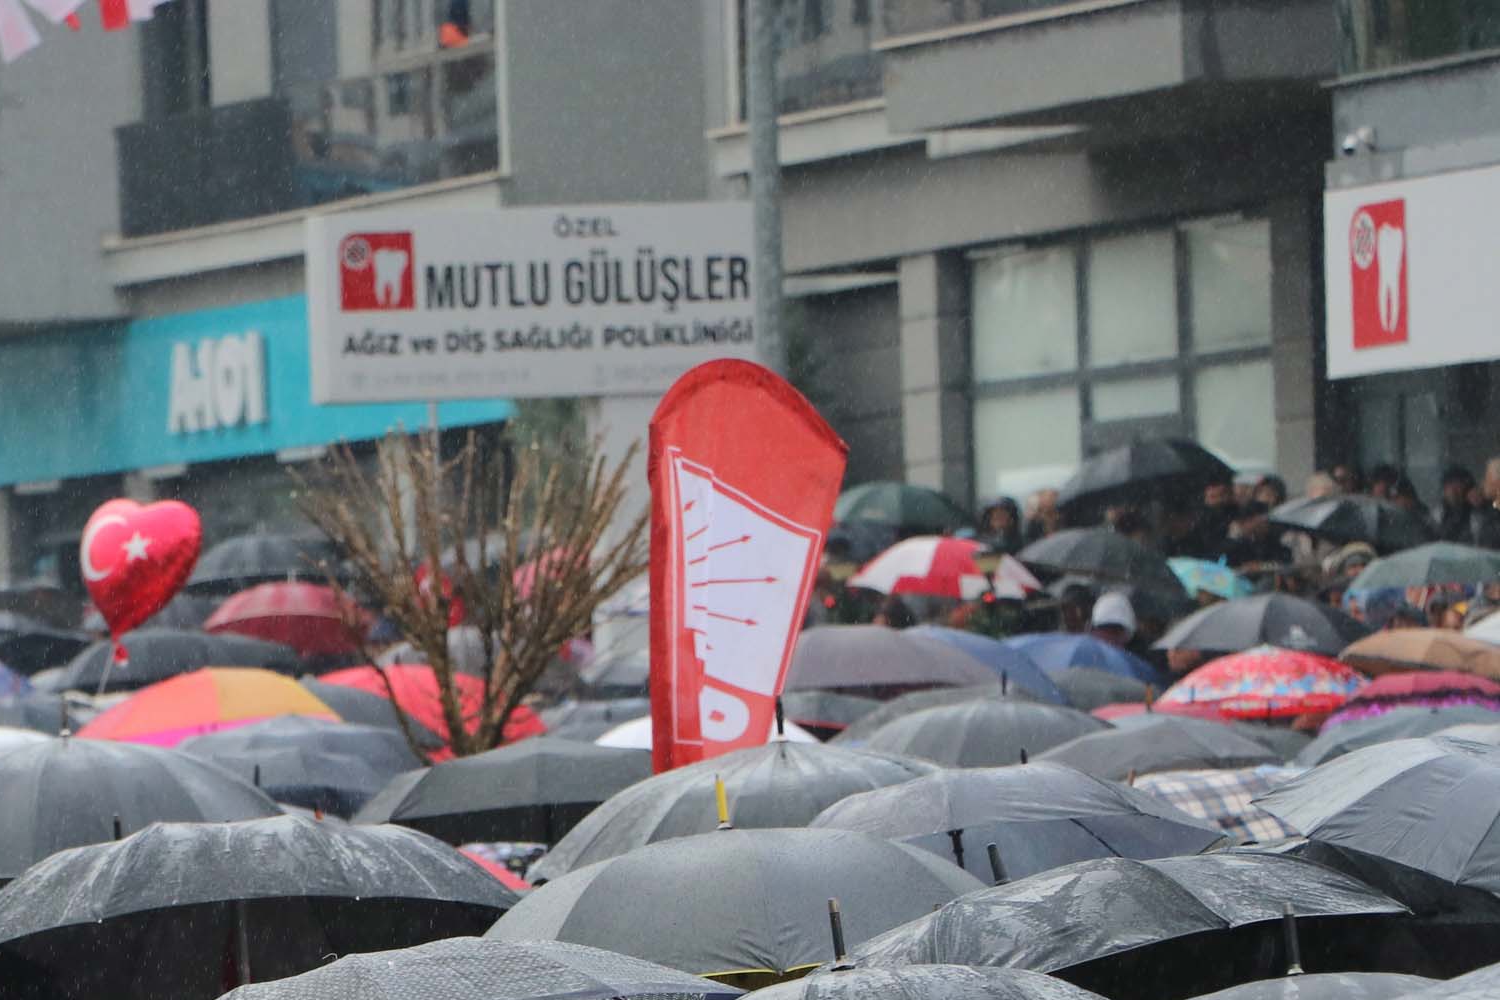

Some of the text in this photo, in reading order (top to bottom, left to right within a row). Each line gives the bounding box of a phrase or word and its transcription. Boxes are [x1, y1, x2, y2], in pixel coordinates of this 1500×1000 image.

[553, 216, 619, 239] ÖZEL
[425, 248, 750, 313] MUTLU GÜLÜŞLER
[409, 336, 437, 354] ve
[497, 321, 593, 351] SAĞLIĞI
